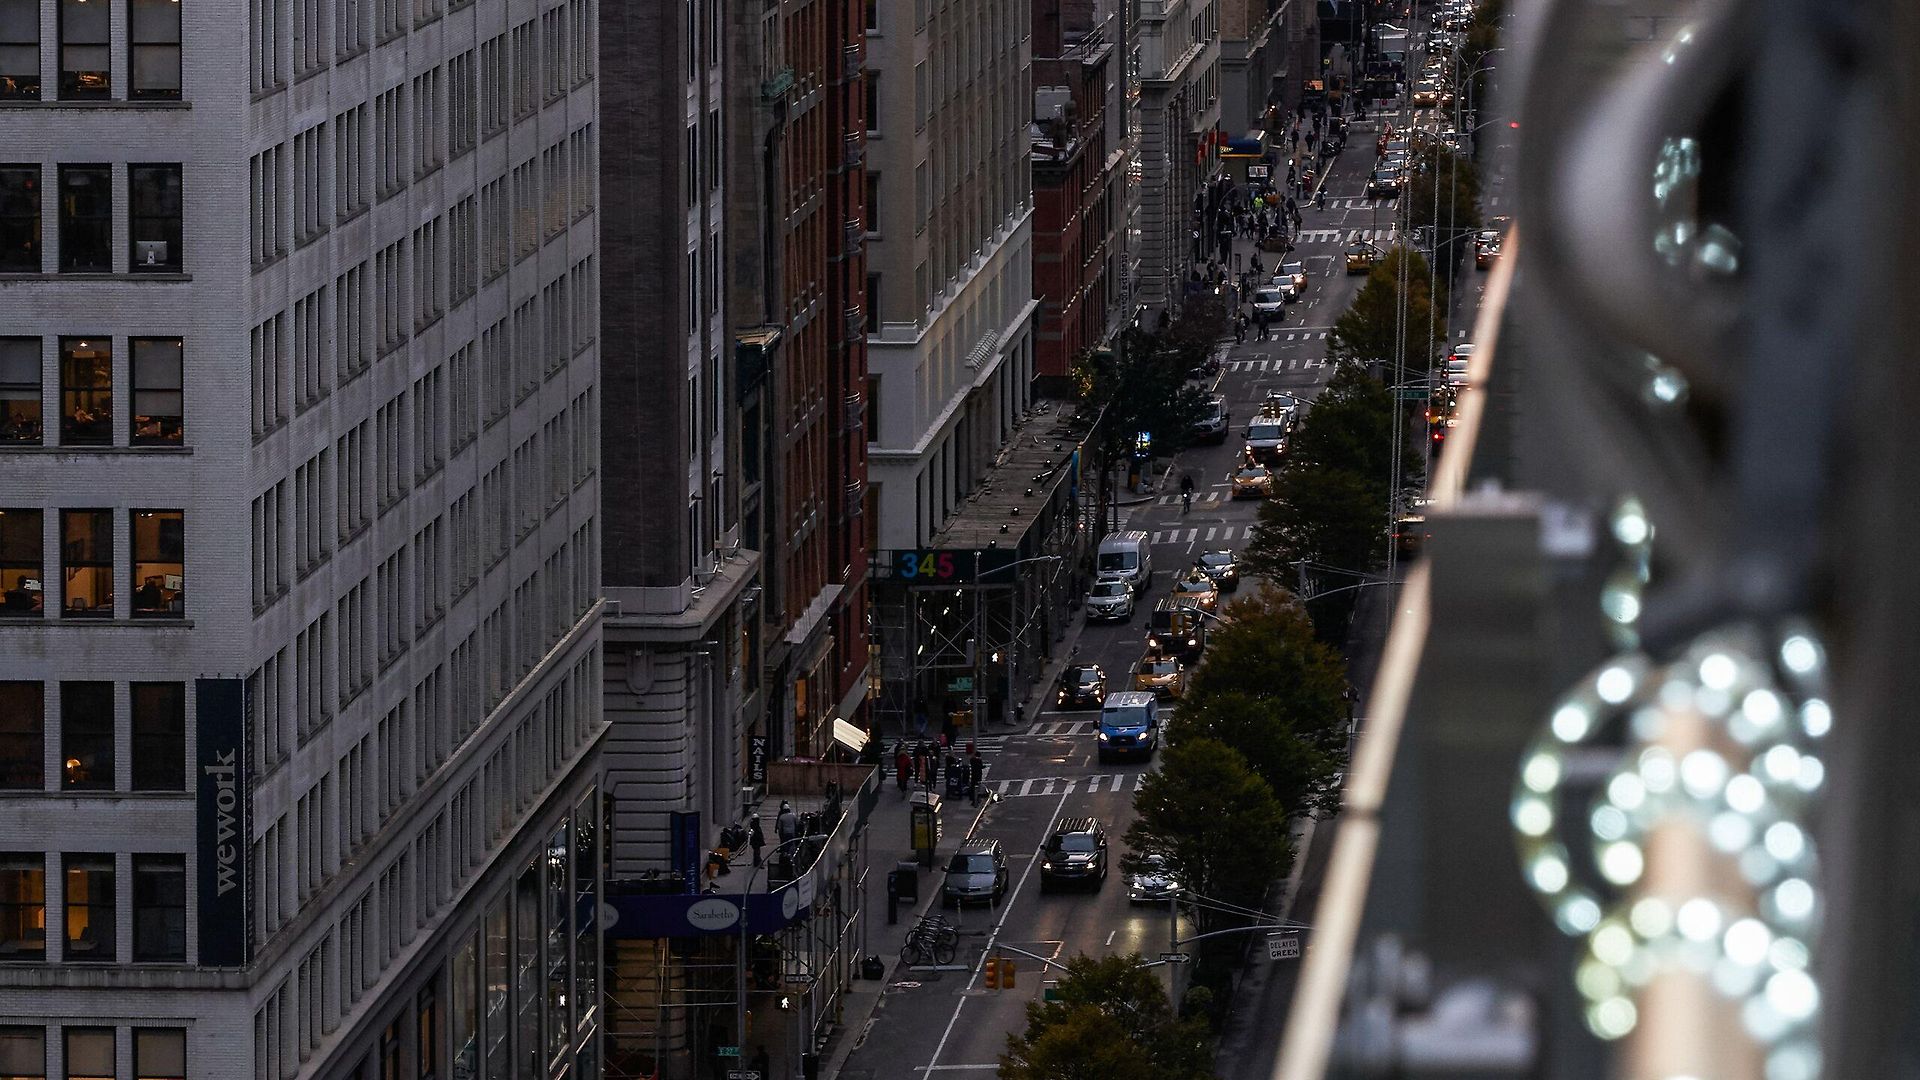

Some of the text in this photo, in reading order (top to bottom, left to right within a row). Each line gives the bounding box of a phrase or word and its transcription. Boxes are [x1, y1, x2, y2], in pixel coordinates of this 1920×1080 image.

[901, 551, 956, 578] 345
[752, 738, 765, 780] NAILS
[205, 748, 236, 897] wework
[1270, 940, 1296, 949] DELAYED
[1271, 949, 1298, 958] GREEN
